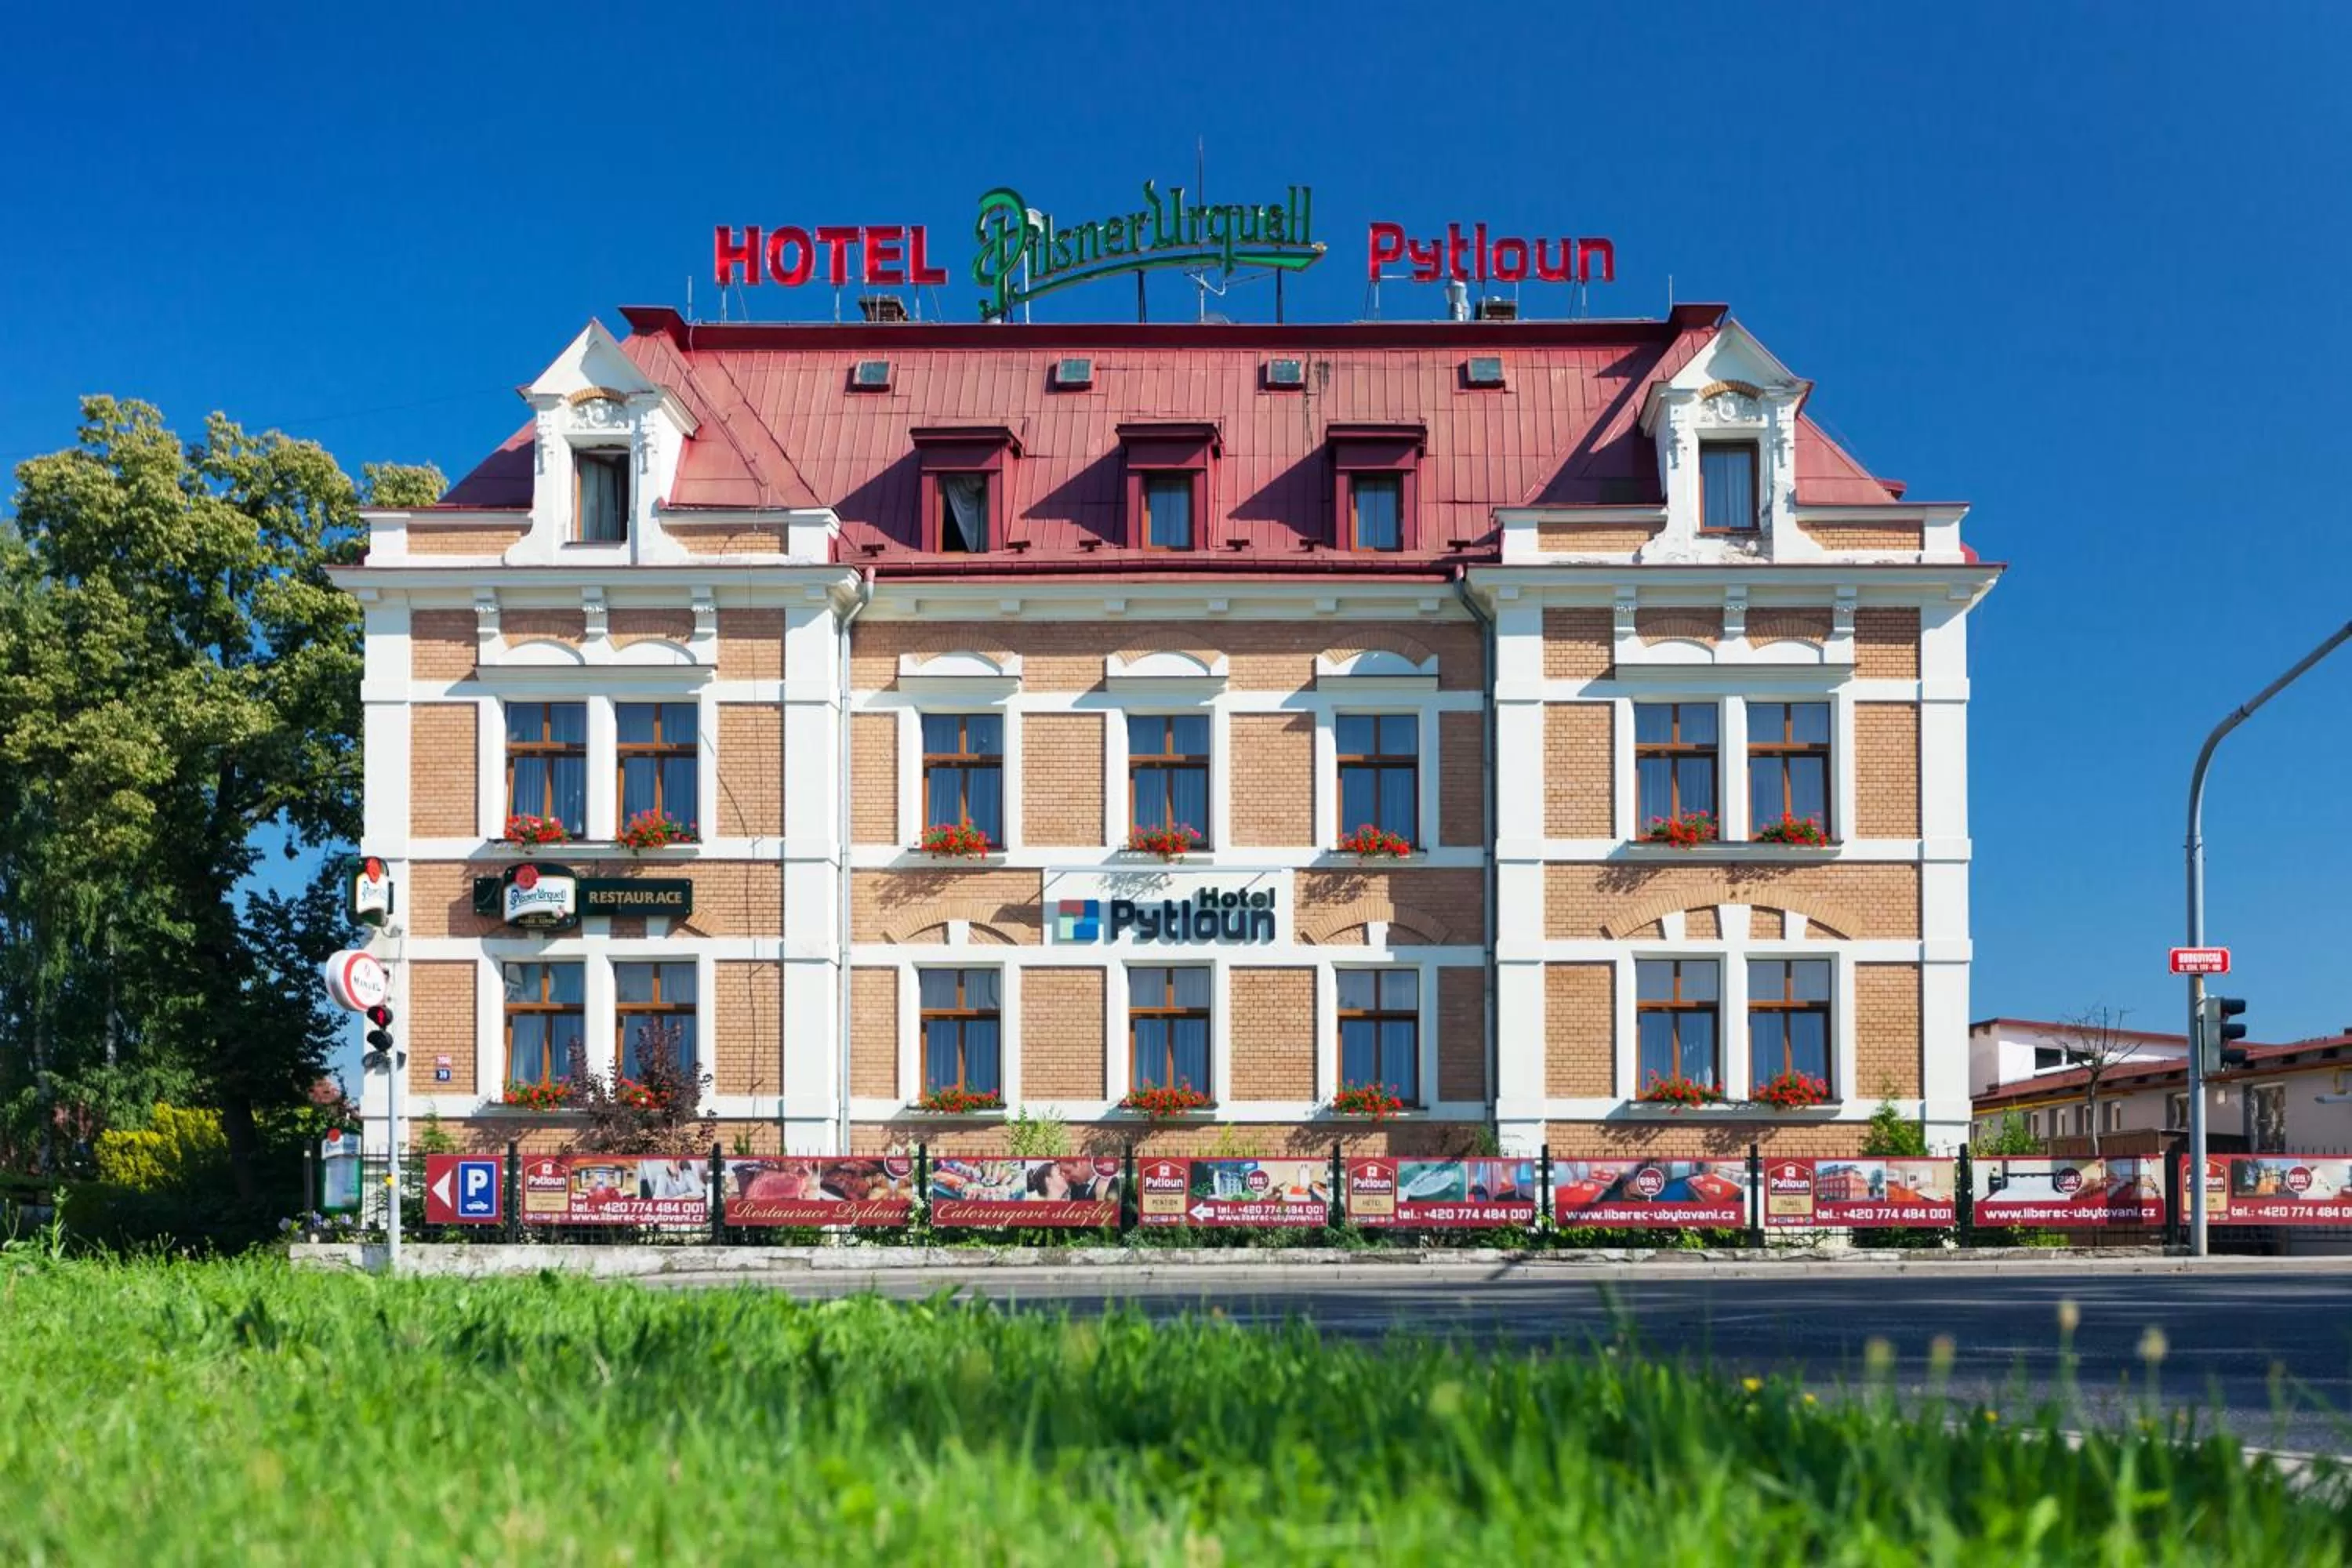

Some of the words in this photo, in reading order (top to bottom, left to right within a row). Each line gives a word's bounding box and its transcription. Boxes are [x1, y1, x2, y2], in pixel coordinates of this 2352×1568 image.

[972, 187, 1148, 317] Pilsner
[1143, 179, 1313, 277] Urquell
[1368, 222, 1615, 282] Pytloun
[714, 225, 948, 287] HOTEL
[590, 891, 682, 904] RESTAURACE
[1199, 887, 1276, 909] Hotel
[1110, 900, 1276, 941] Pytloun
[467, 1169, 488, 1197] P
[528, 1175, 565, 1186] Pytloun
[1145, 1177, 1183, 1189] Pytloun
[1353, 1177, 1391, 1189] Pytloun
[1771, 1178, 1809, 1189] Pytloun
[571, 1202, 595, 1213] tel.:
[598, 1202, 627, 1213] +420
[631, 1202, 653, 1213] 774
[656, 1202, 679, 1213] 484
[682, 1202, 705, 1213] 001
[733, 1201, 829, 1218] Restaurace
[937, 1201, 1048, 1225] Cateringové
[1052, 1201, 1114, 1226] služby
[1238, 1205, 1261, 1214] +420
[1265, 1205, 1283, 1214] 774
[1286, 1205, 1303, 1214] 484
[1306, 1205, 1324, 1214] 001
[1398, 1208, 1421, 1219] tel.:
[1425, 1208, 1454, 1219] +420
[1457, 1208, 1480, 1219] 774
[1483, 1208, 1506, 1219] 484
[1510, 1208, 1532, 1219] 001
[1817, 1208, 1840, 1219] tel.:
[1843, 1208, 1873, 1219] +420
[1876, 1208, 1900, 1219] 774
[1903, 1208, 1926, 1219] 484
[1929, 1208, 1951, 1219] 001
[1984, 1207, 2156, 1221] www.liberec-ubytovani.cz
[2231, 1206, 2255, 1217] tel.:
[2258, 1206, 2288, 1217] +420
[2291, 1206, 2314, 1217] 774
[2317, 1206, 2339, 1217] 484
[1566, 1208, 1736, 1222] www.liberec-ubytovani.cz
